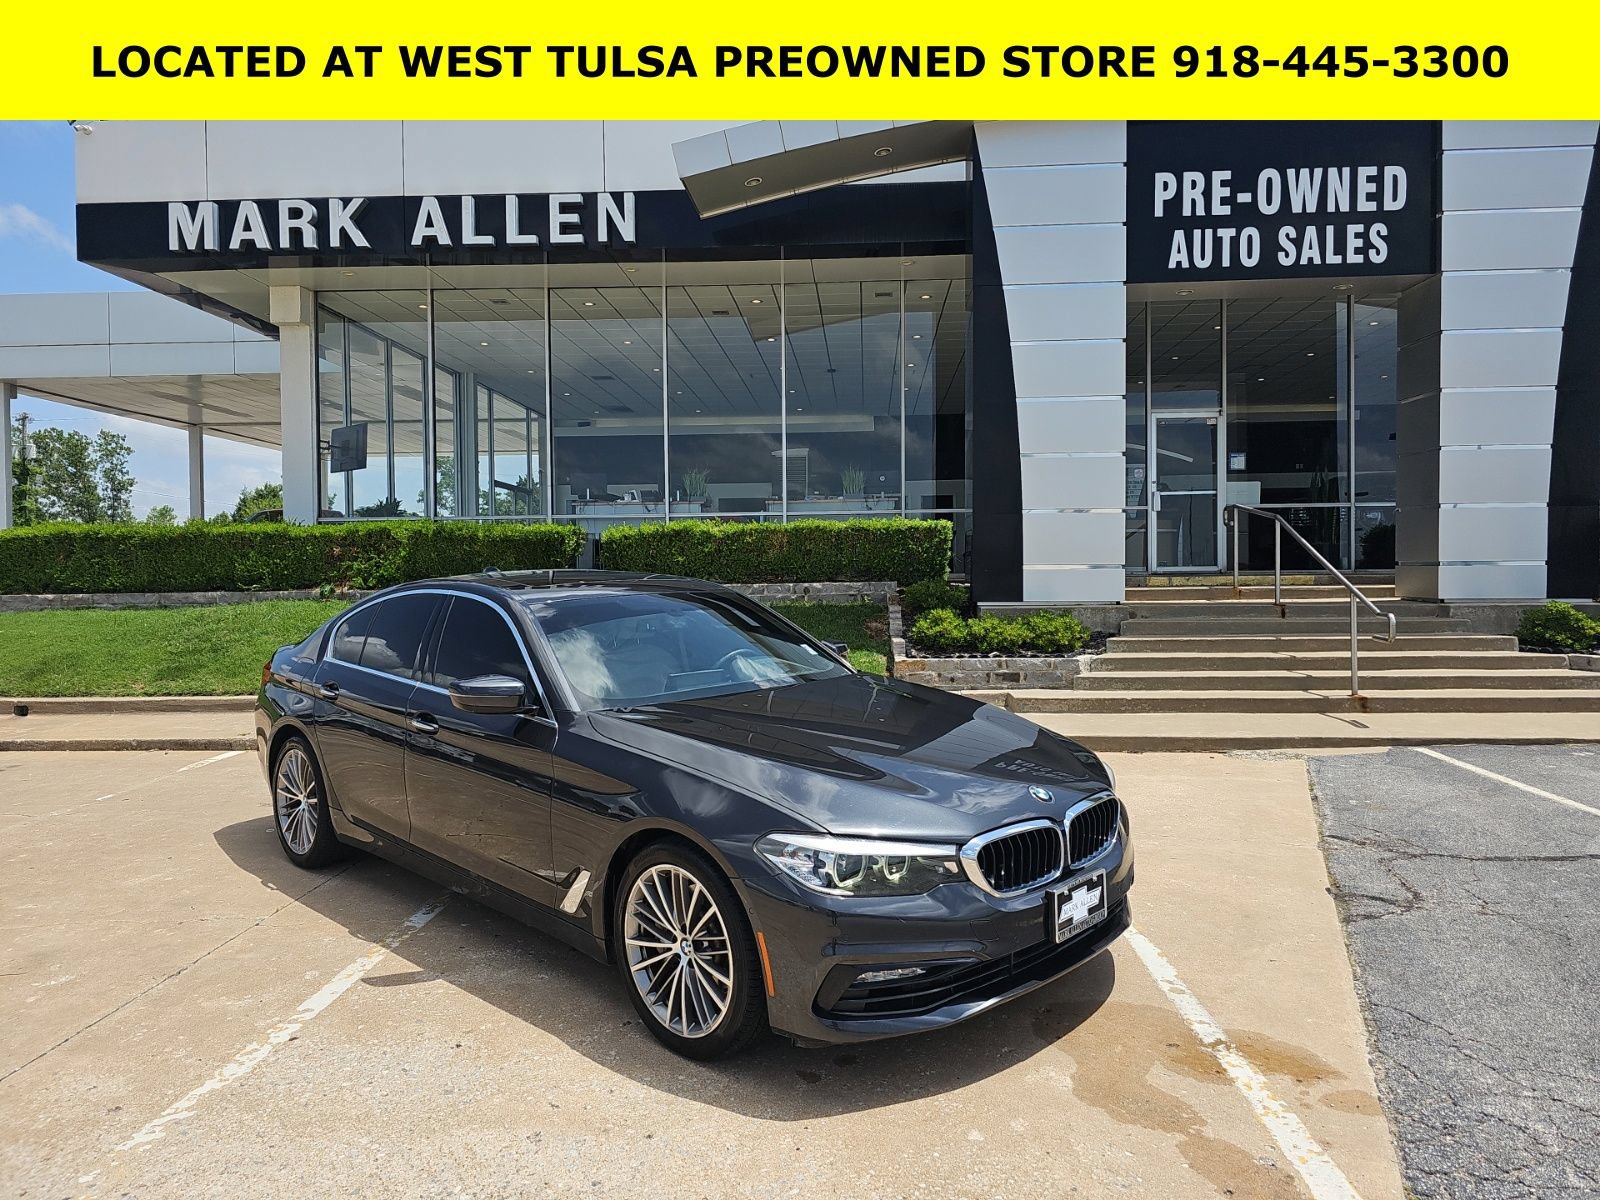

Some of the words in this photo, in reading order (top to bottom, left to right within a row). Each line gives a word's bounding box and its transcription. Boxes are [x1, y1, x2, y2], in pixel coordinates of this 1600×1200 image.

[1153, 165, 1407, 218] PRE-OWNED
[167, 197, 372, 252] MARK
[410, 191, 638, 247] ALLEN
[1168, 227, 1260, 270] AUTO
[1277, 223, 1388, 266] SALES
